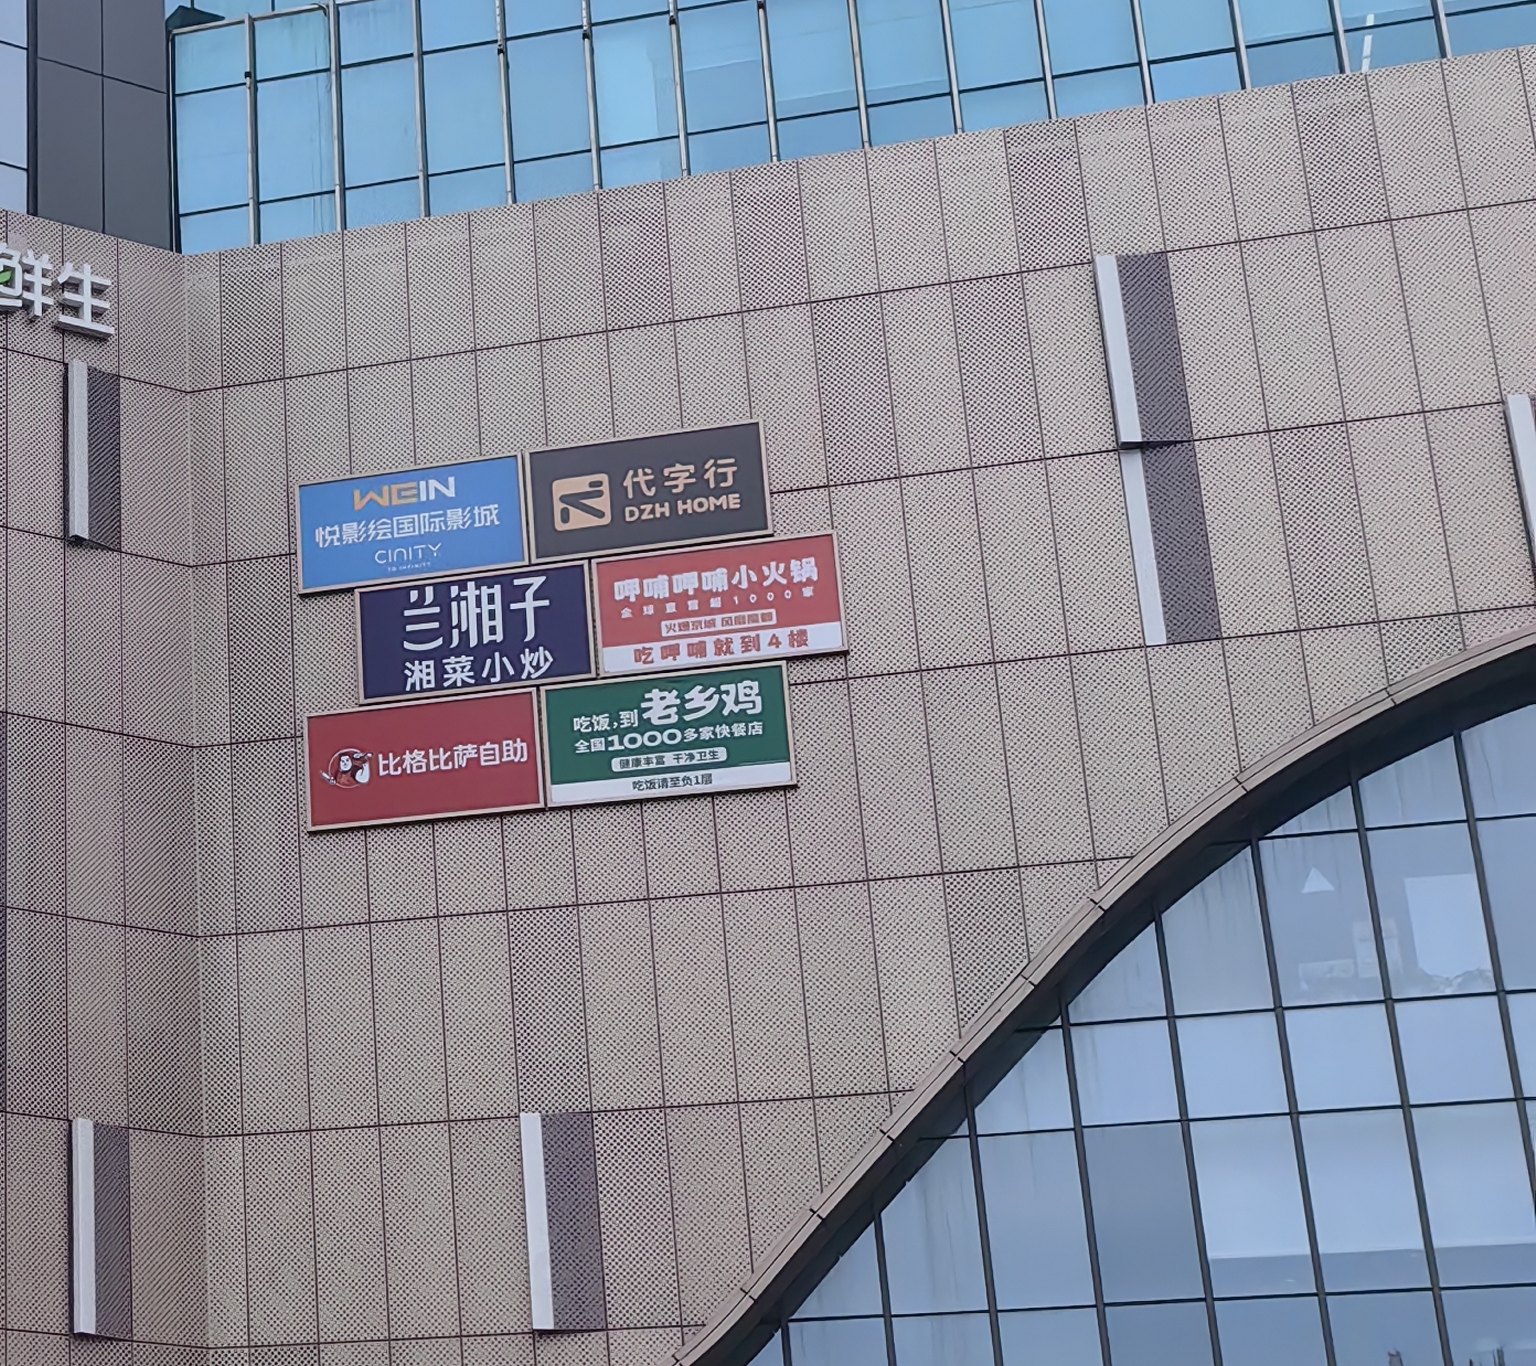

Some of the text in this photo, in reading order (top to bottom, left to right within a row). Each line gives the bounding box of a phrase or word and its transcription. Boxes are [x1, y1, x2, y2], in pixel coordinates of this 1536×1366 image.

[353, 476, 456, 511] WEIN
[623, 458, 738, 499] 代字行
[315, 503, 500, 548] 悦影绘国际影城
[624, 493, 741, 522] DZH HOME
[374, 542, 443, 565] CINITY
[614, 557, 818, 602] 呷哺呷哺小火锅
[403, 575, 551, 652] 兰湘子
[403, 646, 554, 692] 湘菜小炒
[377, 737, 528, 777] 比格比萨自助
[574, 721, 764, 754] 全国1000多家快餐店
[618, 749, 720, 770] 健康丰富 干净卫生
